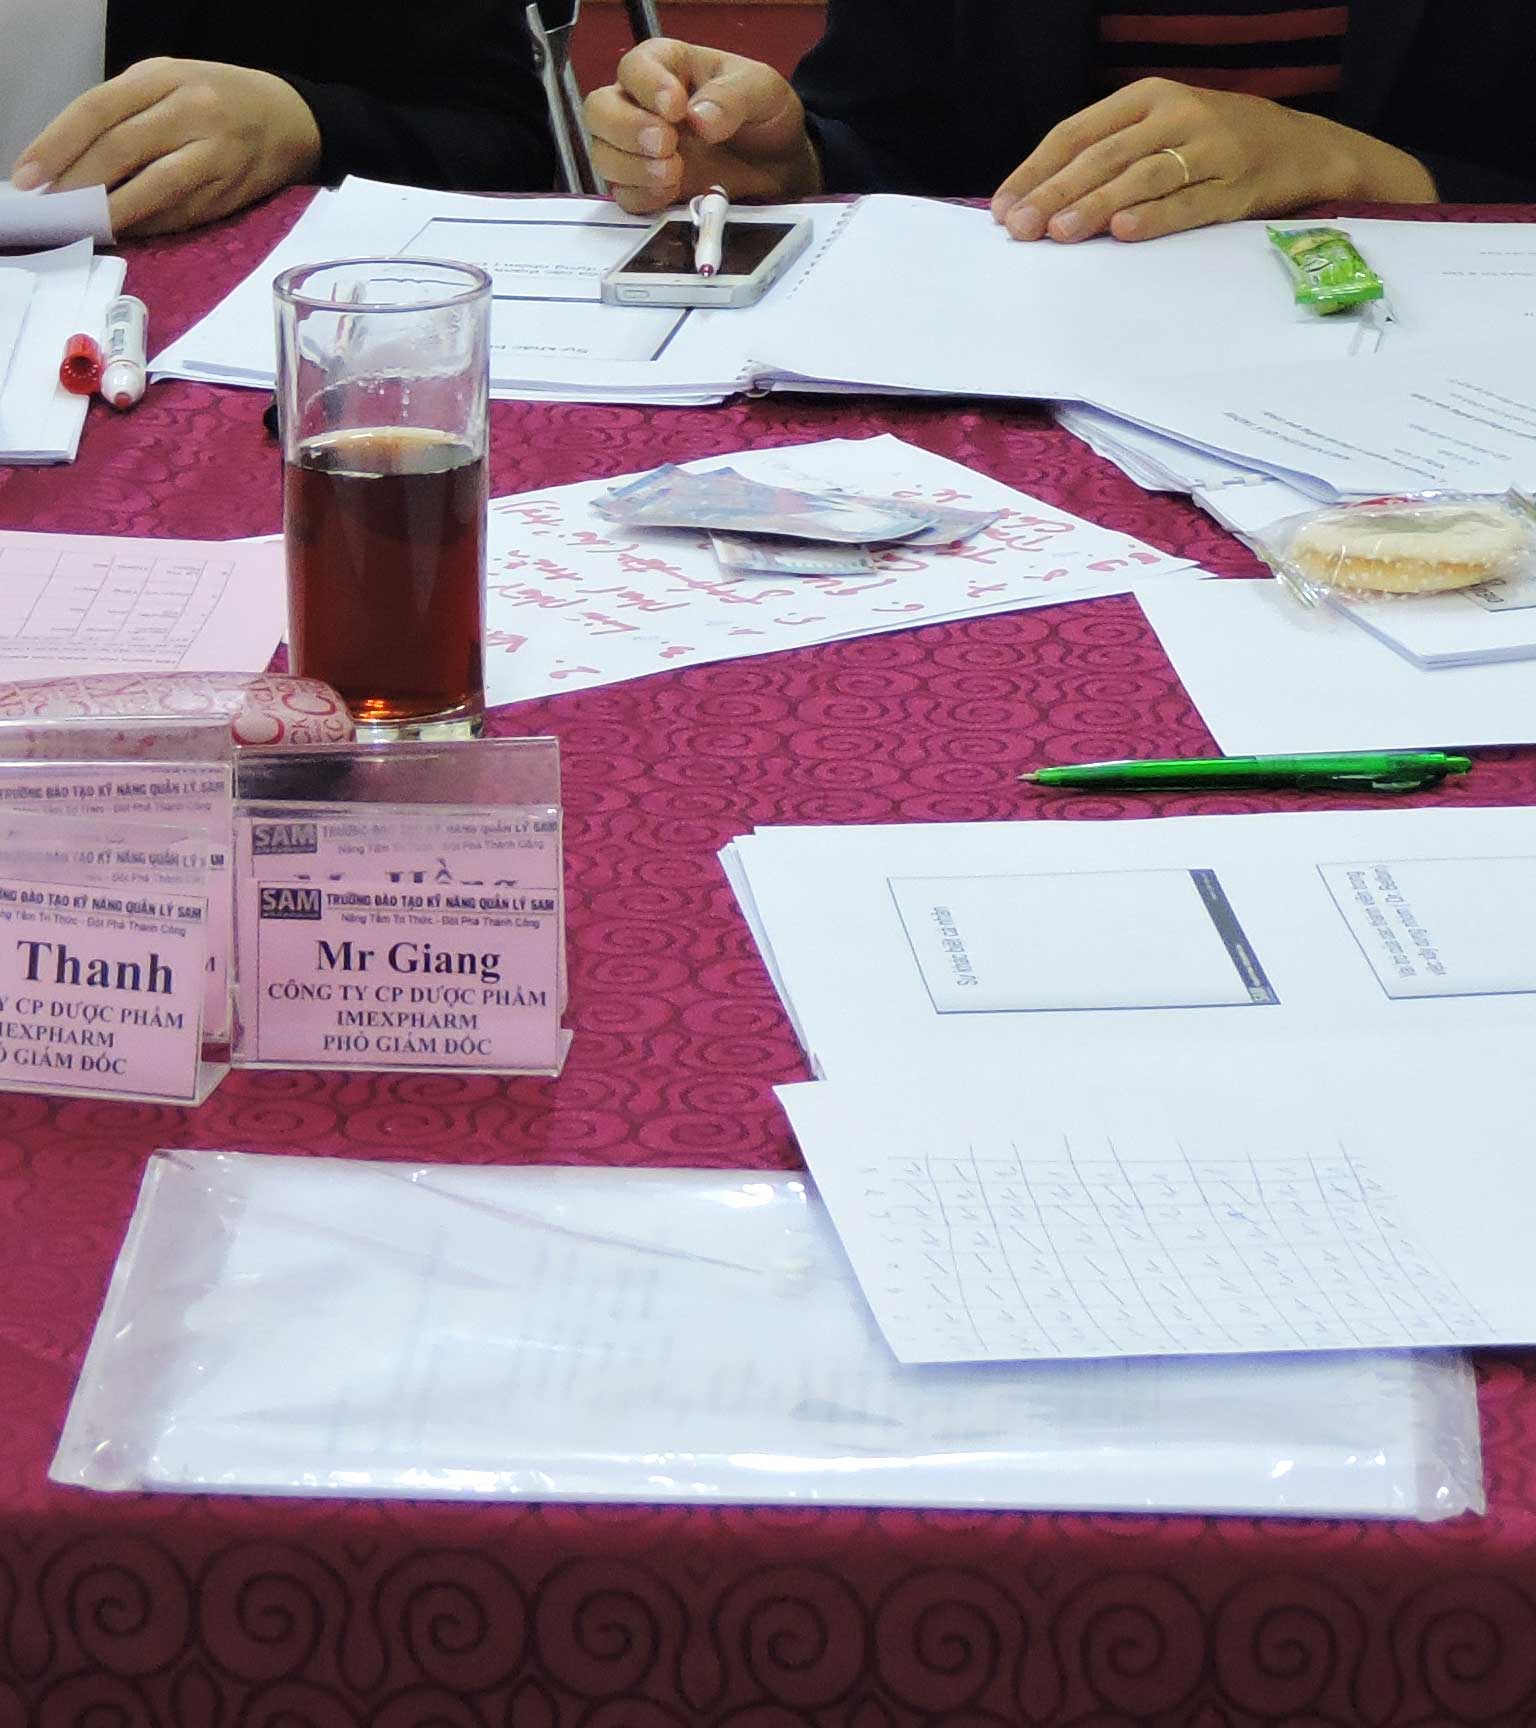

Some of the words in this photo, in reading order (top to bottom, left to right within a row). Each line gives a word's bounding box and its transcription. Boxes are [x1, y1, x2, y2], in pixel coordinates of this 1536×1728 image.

[261, 890, 321, 914] SAM
[16, 940, 174, 995] Thanh
[316, 939, 375, 972] Mr
[388, 941, 502, 984] Giang
[268, 978, 332, 1001] CÔNG
[339, 984, 368, 1001] TY
[375, 985, 404, 1002] CP
[15, 997, 44, 1015] CP
[336, 1010, 478, 1030] IMEXPHARM
